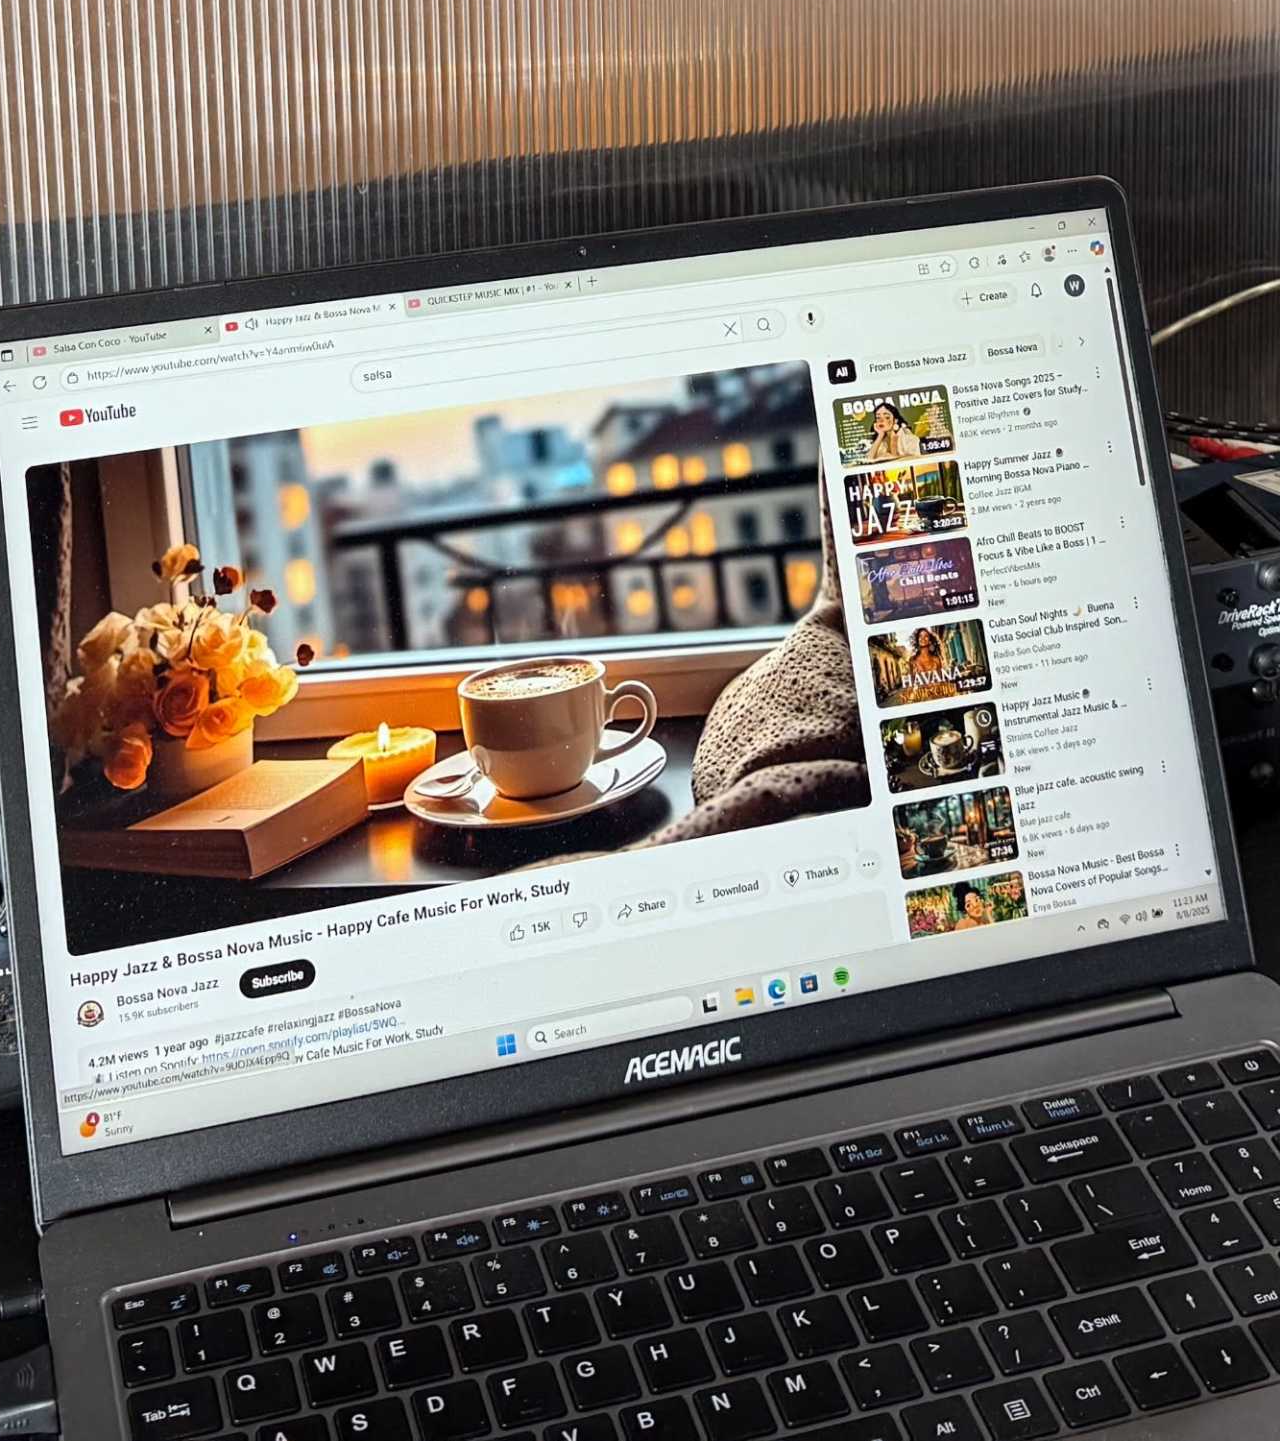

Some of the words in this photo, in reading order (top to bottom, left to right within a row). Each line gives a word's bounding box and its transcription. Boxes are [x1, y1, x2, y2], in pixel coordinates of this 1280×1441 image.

[475, 289, 502, 301] MUSIC
[979, 291, 1007, 302] Create
[53, 342, 76, 354] Salsa
[79, 340, 97, 350] Con
[98, 337, 120, 347] Coco
[129, 331, 167, 344] YouTube
[988, 347, 1014, 357] Bossa
[1016, 343, 1038, 353] Nova
[869, 362, 892, 373] From
[894, 358, 921, 369] Bossa
[923, 355, 945, 365] Nova
[948, 352, 967, 362] Jazz
[363, 369, 392, 382] salsa
[836, 367, 848, 378] All
[952, 384, 979, 395] Bossa
[981, 380, 1003, 391] Nova
[1005, 376, 1031, 389] Songs
[1033, 373, 1055, 384] 2025
[899, 391, 945, 406] NOVA
[955, 396, 989, 409] Positive
[992, 393, 1010, 404] Jazz
[1013, 389, 1042, 401] Covers
[1044, 387, 1055, 397] for
[85, 403, 136, 423] YouTube
[964, 458, 991, 471] Happy
[993, 454, 1029, 467] Summer
[1032, 449, 1051, 460] Jazz
[966, 472, 1002, 486] Morning
[1004, 468, 1031, 479] Bossa
[1033, 465, 1054, 475] Nova
[1056, 461, 1081, 473] Piano
[849, 481, 907, 502] HAPPY
[852, 500, 912, 537] JAZZ
[976, 535, 995, 547] Afro
[997, 531, 1015, 544] Chill
[1017, 528, 1042, 541] Beats
[1044, 528, 1052, 537] to
[1055, 523, 1085, 535] BOOST
[978, 550, 1004, 562] Focus
[1006, 546, 1013, 557] &
[1015, 543, 1034, 555] Vibe
[1036, 540, 1053, 552] Like
[1055, 541, 1061, 549] a
[1063, 537, 1084, 548] Boss
[989, 617, 1017, 629] Cuban
[1019, 613, 1038, 624] Soul
[1040, 609, 1068, 622] Nights
[1088, 601, 1115, 613] Buena
[991, 632, 1014, 644] Vista
[1015, 627, 1043, 640] Social
[1045, 624, 1063, 635] Club
[1066, 617, 1100, 633] Inspired
[901, 668, 962, 688] HAVANA
[1002, 699, 1030, 712] Happy
[1032, 695, 1052, 707] Jazz
[1054, 691, 1081, 703] Music
[1004, 710, 1060, 728] Instrumental
[1062, 706, 1082, 718] Jazz
[1083, 702, 1110, 714] Music
[1111, 700, 1119, 710] &
[1015, 784, 1035, 796] Blue
[1036, 781, 1054, 795] jazz
[1080, 769, 1117, 784] acoustic
[1119, 765, 1144, 778] swing
[1017, 800, 1035, 814] jazz
[805, 865, 839, 881] Thanks
[1028, 869, 1056, 880] Bossa
[1058, 864, 1080, 876] Nova
[1082, 859, 1109, 871] Music
[1116, 852, 1136, 864] Best
[1138, 847, 1165, 859] Bossa
[712, 880, 760, 899] Download
[1030, 885, 1053, 896] Nova
[1056, 879, 1085, 892] Covers
[1088, 876, 1097, 886] of
[1099, 869, 1132, 884] Popular
[638, 898, 666, 913] Share
[70, 968, 118, 987] Happy
[122, 960, 158, 977] Jazz
[162, 956, 172, 969] &
[177, 948, 223, 967] Bossa
[227, 939, 265, 957] Nova
[268, 930, 313, 948] Music
[327, 918, 372, 938] Happy
[377, 911, 410, 928] Cafe
[414, 902, 456, 920] Music
[461, 897, 482, 912] For
[486, 888, 527, 906] Work,
[531, 879, 570, 898] Study
[532, 922, 550, 934] 15K
[251, 969, 304, 990] Subscribe
[117, 992, 153, 1007] Bossa
[157, 985, 188, 999] Nova
[191, 978, 219, 993] Jazz
[119, 1011, 144, 1023] 15.9K
[147, 999, 199, 1018] subscribers
[88, 1055, 116, 1068] 4.2M
[118, 1048, 148, 1062] views
[155, 1046, 160, 1056] 1
[163, 1042, 189, 1058] year
[189, 1038, 209, 1052] ago
[215, 1026, 265, 1046] #jazzcafe
[267, 1011, 335, 1034] #relaxingjazz
[338, 999, 402, 1021] #BossaNova
[554, 1024, 587, 1040] Search
[624, 1035, 742, 1084] ACEMAGIC
[1042, 1096, 1076, 1110] Delete
[105, 1124, 134, 1140] Sunny
[1039, 1134, 1099, 1156] Backspace
[1179, 1183, 1212, 1198] Home
[1128, 1234, 1161, 1251] Enter
[288, 1263, 303, 1273] F2
[124, 1299, 145, 1310] Esc
[1254, 1290, 1278, 1305] End
[537, 1306, 551, 1323] T
[1093, 1313, 1121, 1328] Shift
[462, 1323, 481, 1340] R
[389, 1339, 407, 1357] E
[314, 1355, 336, 1374] W
[237, 1374, 256, 1391] Q
[1075, 1385, 1101, 1401] Ctrl
[142, 1409, 167, 1424] Tab
[936, 1421, 956, 1437] Alt
